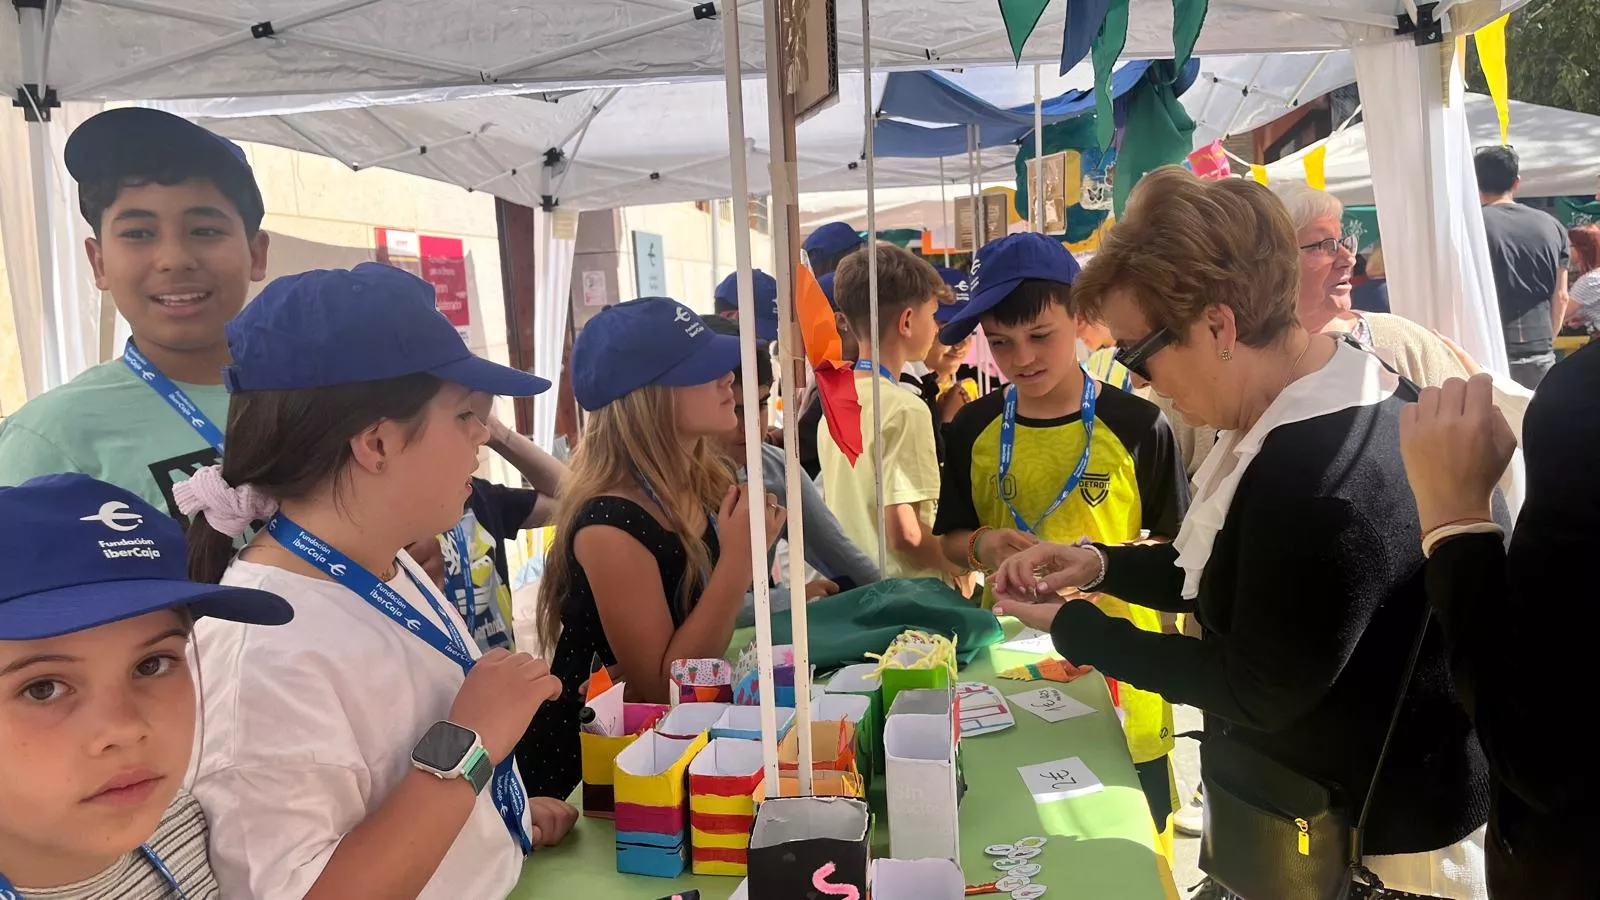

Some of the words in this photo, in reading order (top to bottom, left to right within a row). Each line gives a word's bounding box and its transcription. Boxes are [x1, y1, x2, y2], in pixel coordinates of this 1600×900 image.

[1078, 480, 1111, 488] DETROIT
[98, 538, 154, 548] Fundación
[292, 538, 327, 563] iberCaja
[298, 531, 331, 555] Fundación
[103, 547, 160, 559] iberCaja
[369, 588, 403, 617] iberCaja
